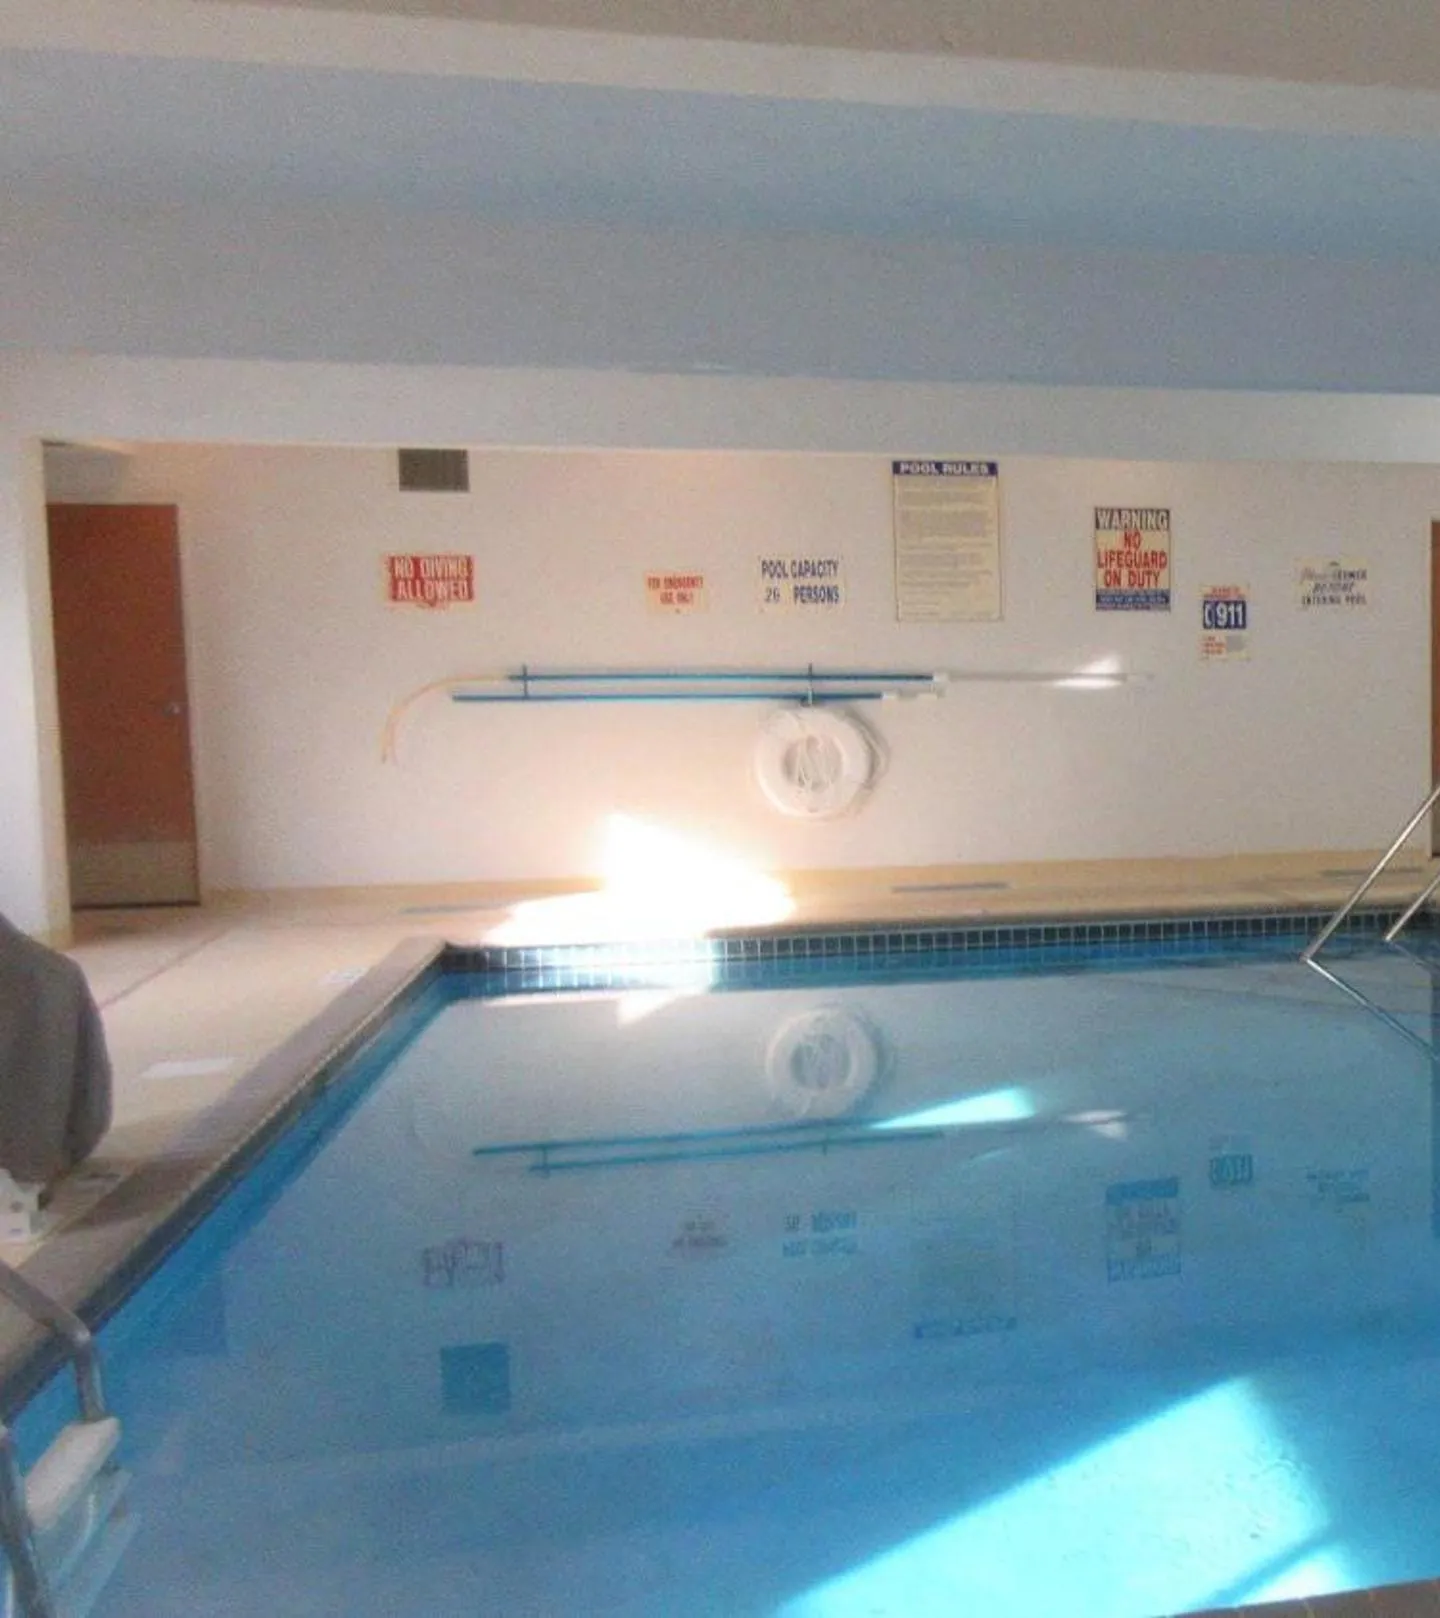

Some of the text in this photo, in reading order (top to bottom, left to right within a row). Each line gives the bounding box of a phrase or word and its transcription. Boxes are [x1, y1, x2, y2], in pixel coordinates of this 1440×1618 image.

[900, 462, 990, 477] POOL RULES
[1097, 509, 1168, 530] WARNING
[1123, 531, 1142, 549] NO
[394, 557, 468, 579] NO DIVING
[761, 559, 839, 579] POOL CAPACITY
[1097, 550, 1167, 569] LIFEGUARD
[1103, 569, 1161, 588] ON DUTY
[397, 579, 468, 601] ALLOWED
[764, 584, 840, 604] 26 PERSONS
[1216, 602, 1244, 627] 911
